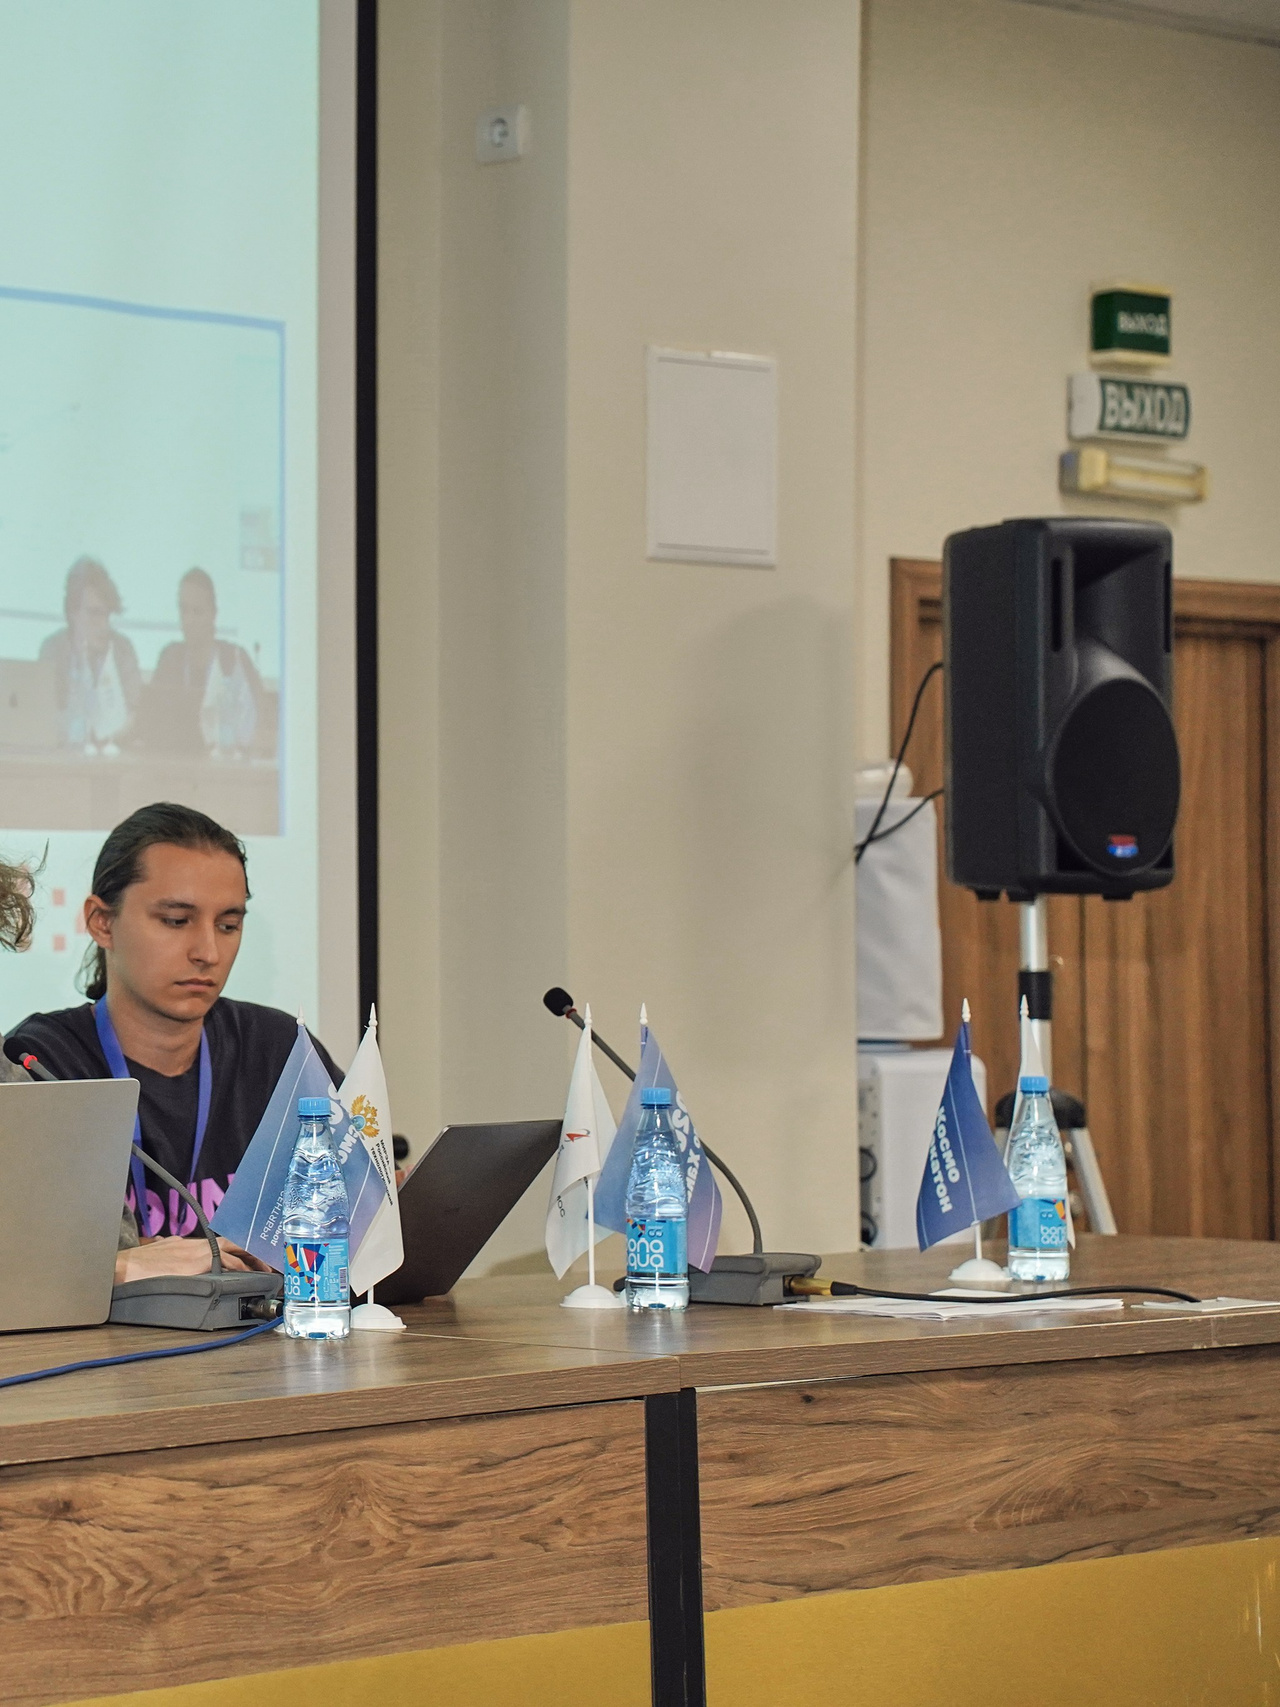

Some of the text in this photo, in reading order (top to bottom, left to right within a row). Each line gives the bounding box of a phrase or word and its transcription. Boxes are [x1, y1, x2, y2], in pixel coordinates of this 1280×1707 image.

[1103, 380, 1185, 434] ВЫХОД
[1040, 1224, 1066, 1236] bon
[627, 1237, 664, 1254] ona
[1040, 1235, 1066, 1246] aqu
[627, 1252, 664, 1270] qua
